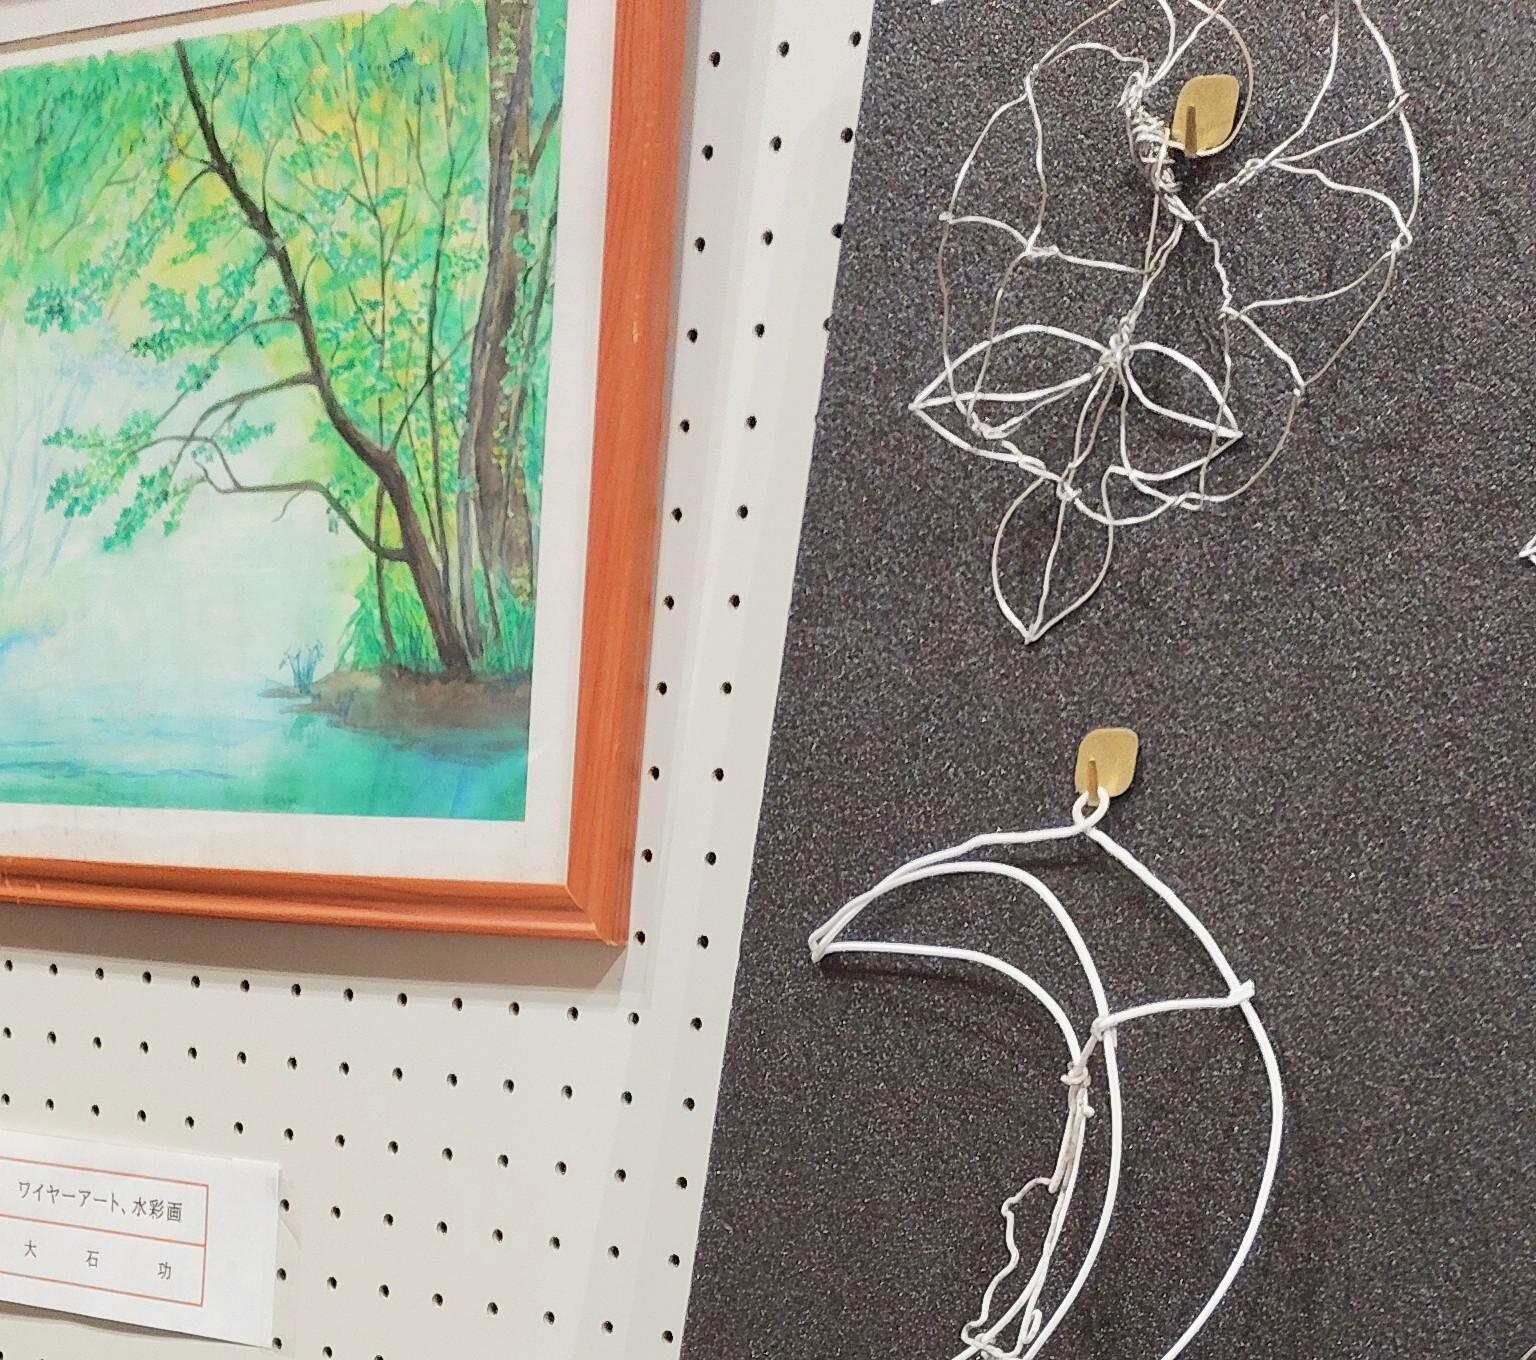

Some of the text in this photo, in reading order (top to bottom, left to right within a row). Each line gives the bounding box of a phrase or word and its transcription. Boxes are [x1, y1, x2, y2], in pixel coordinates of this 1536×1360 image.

[18, 1180, 183, 1223] ワイヤーアート、水彩画
